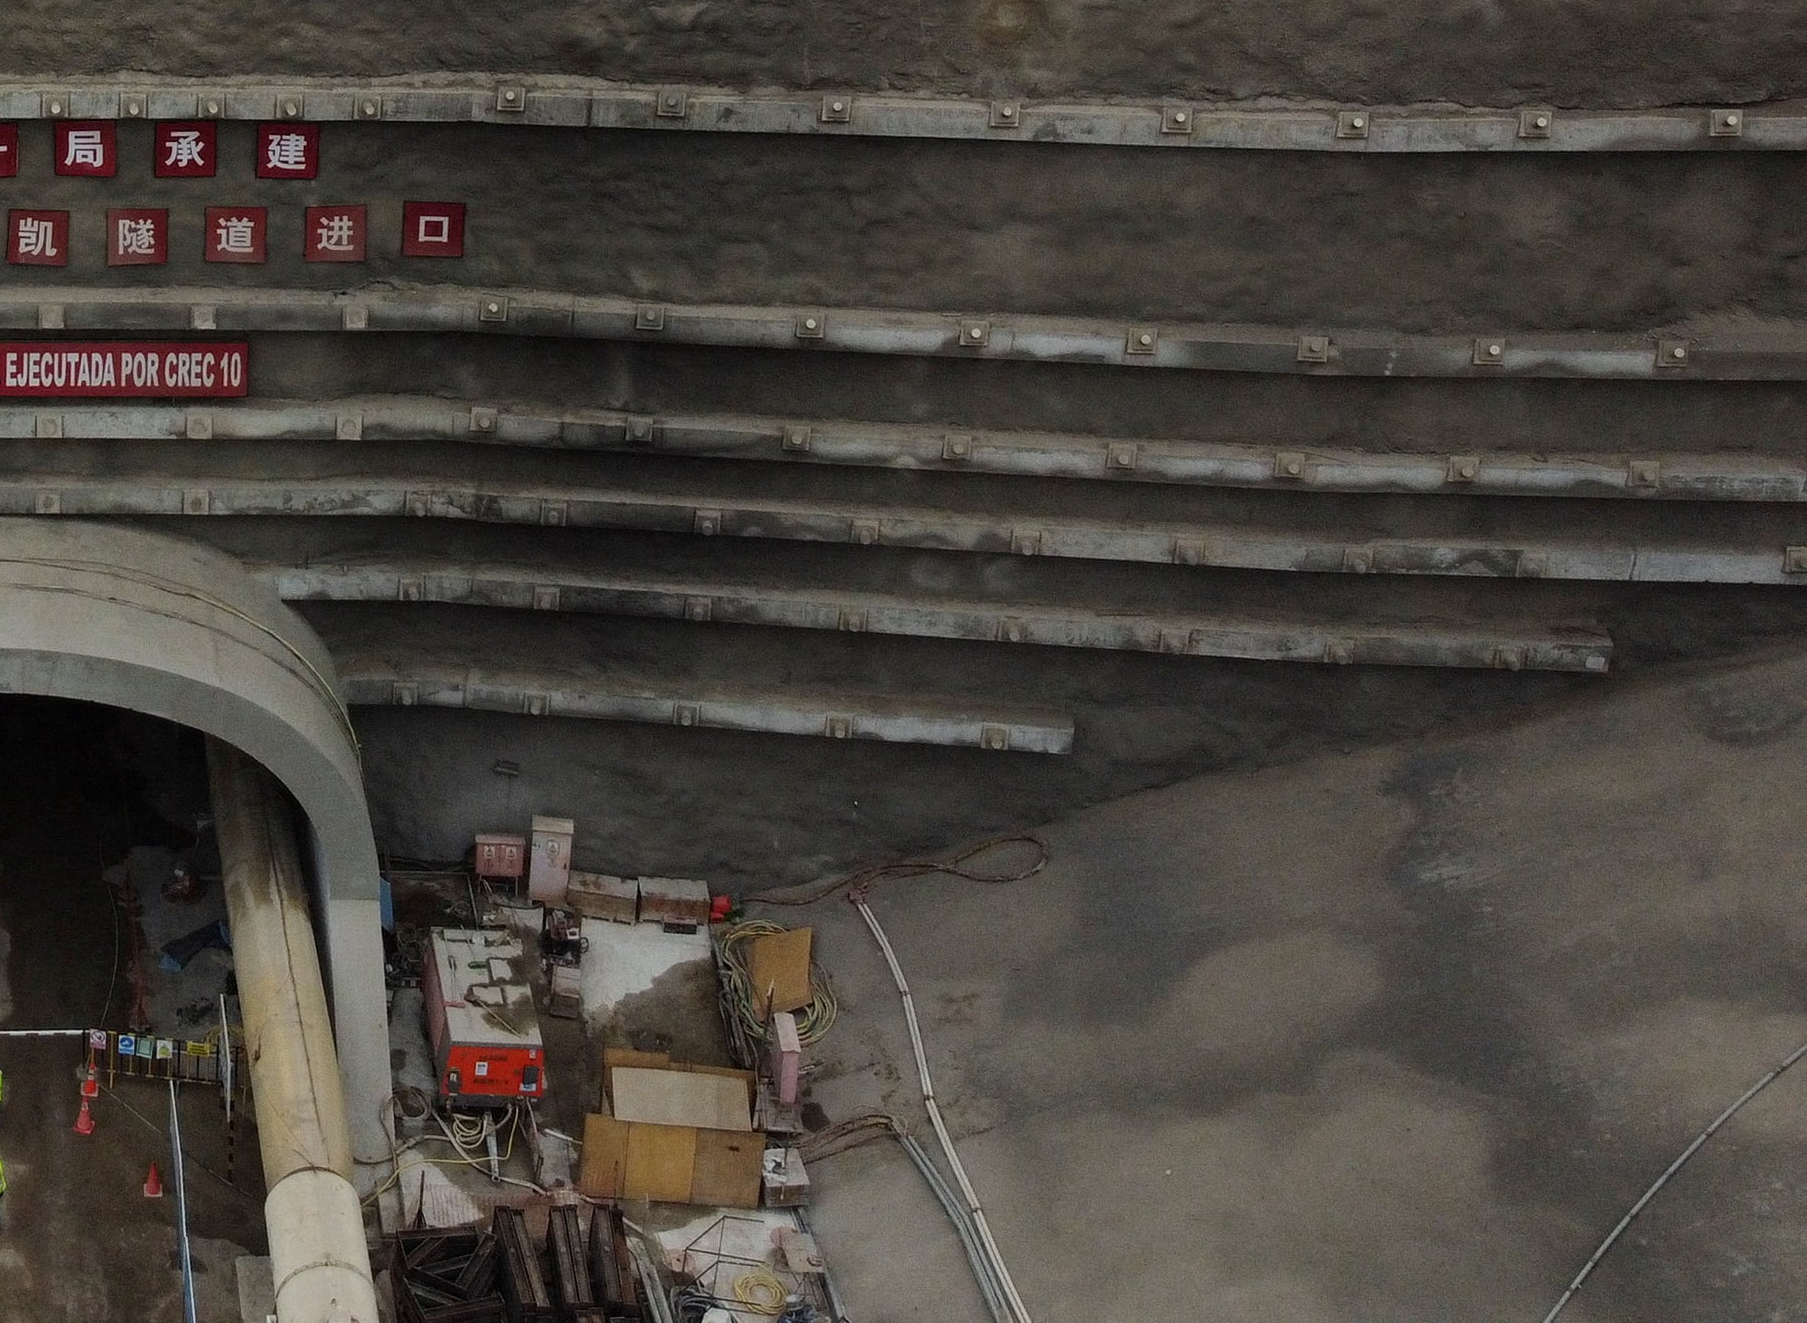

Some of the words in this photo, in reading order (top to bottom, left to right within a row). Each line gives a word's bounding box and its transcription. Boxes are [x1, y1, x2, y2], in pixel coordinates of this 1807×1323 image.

[6, 352, 115, 387] EJECUTADA
[121, 352, 159, 387] POR
[164, 352, 215, 387] CREC
[220, 352, 242, 387] 10
